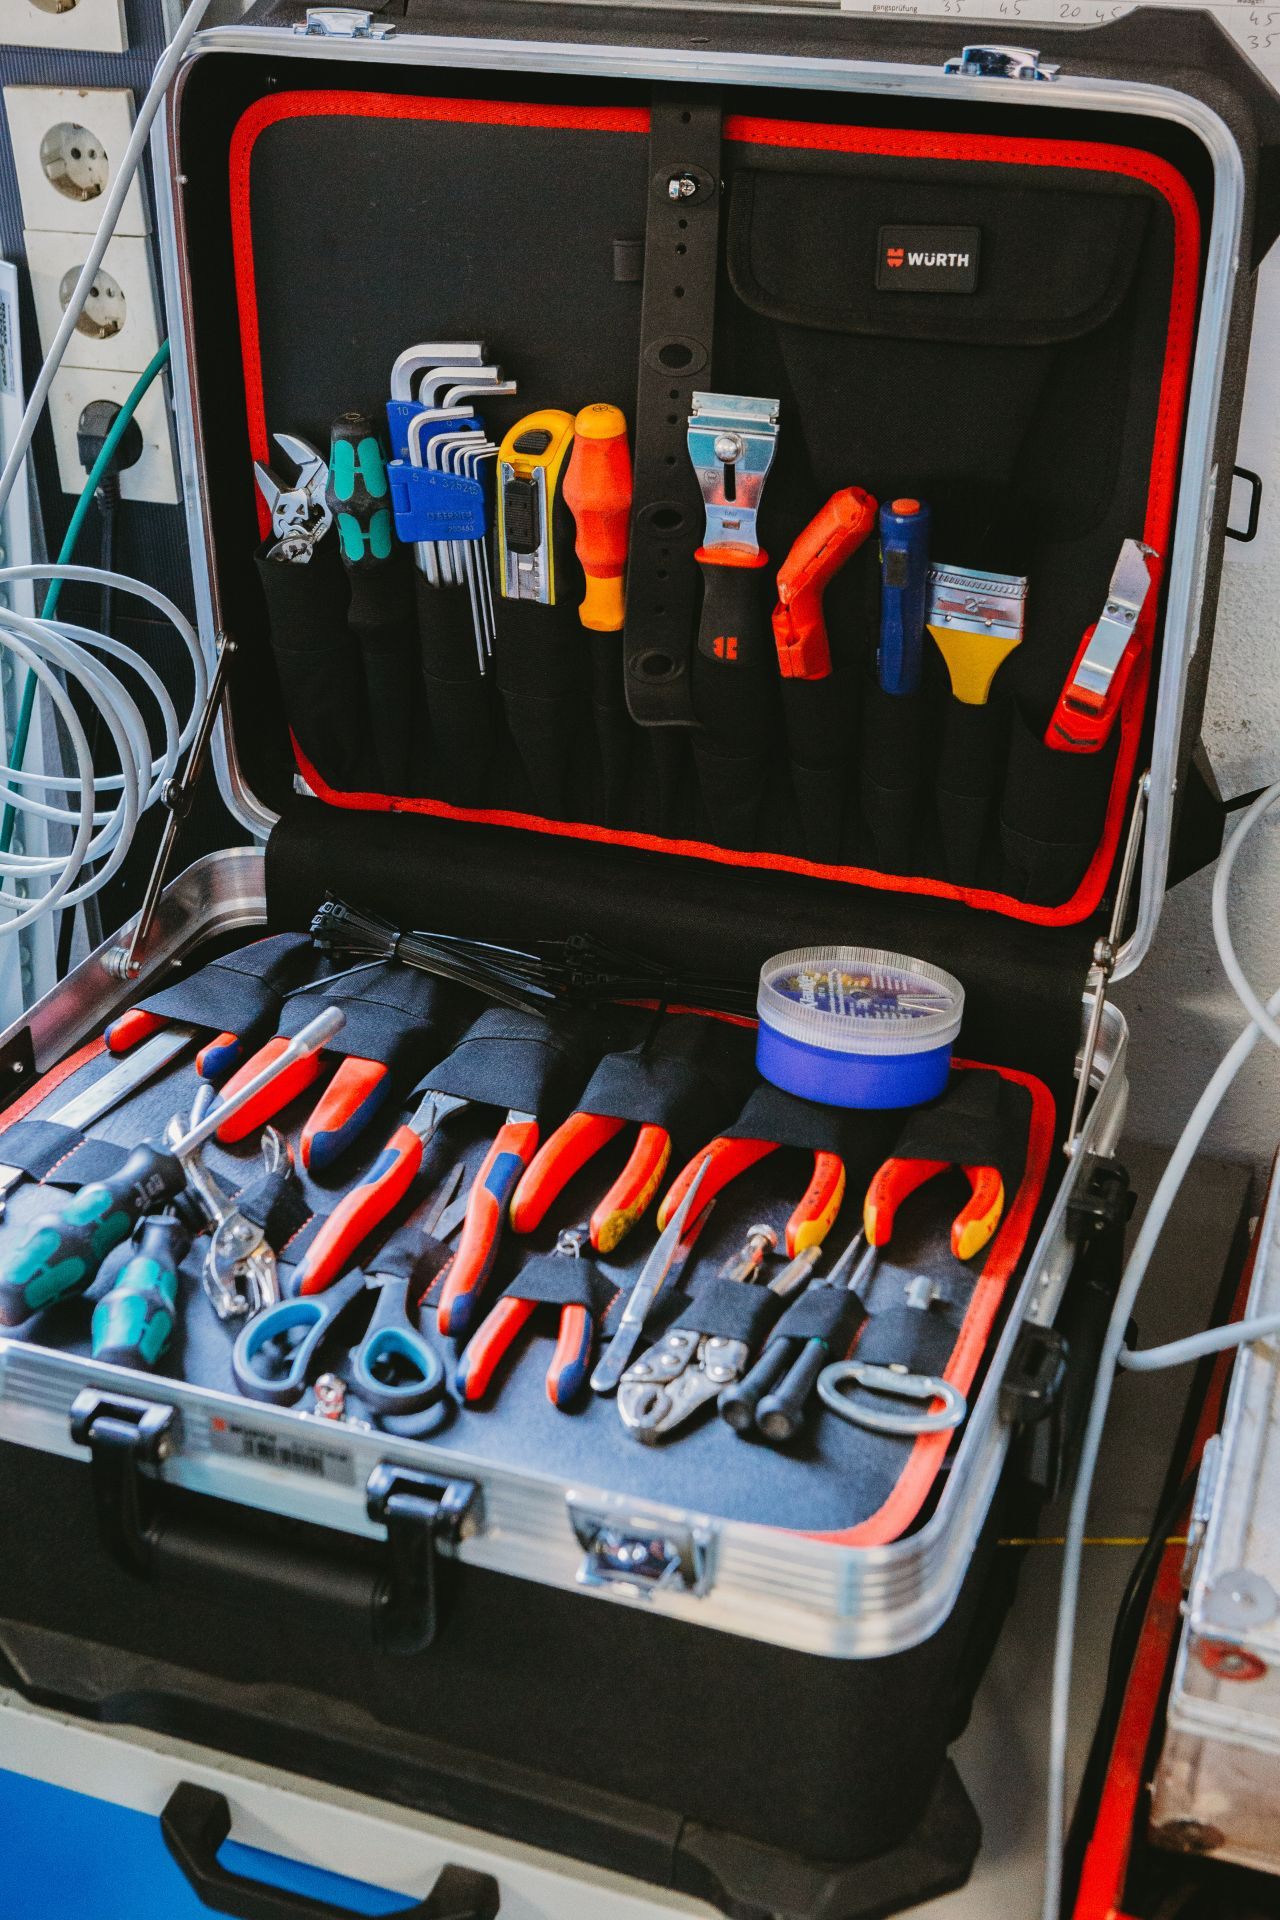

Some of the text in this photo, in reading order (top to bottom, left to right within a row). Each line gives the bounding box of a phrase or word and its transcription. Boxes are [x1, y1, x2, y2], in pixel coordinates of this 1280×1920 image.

[1059, 3, 1081, 18] 20
[1249, 10, 1280, 27] 45
[1248, 32, 1280, 49] 35
[907, 251, 970, 268] WÜRTH
[396, 406, 409, 416] 10
[412, 472, 419, 482] 5
[429, 476, 436, 485] 4
[441, 478, 449, 488] 3
